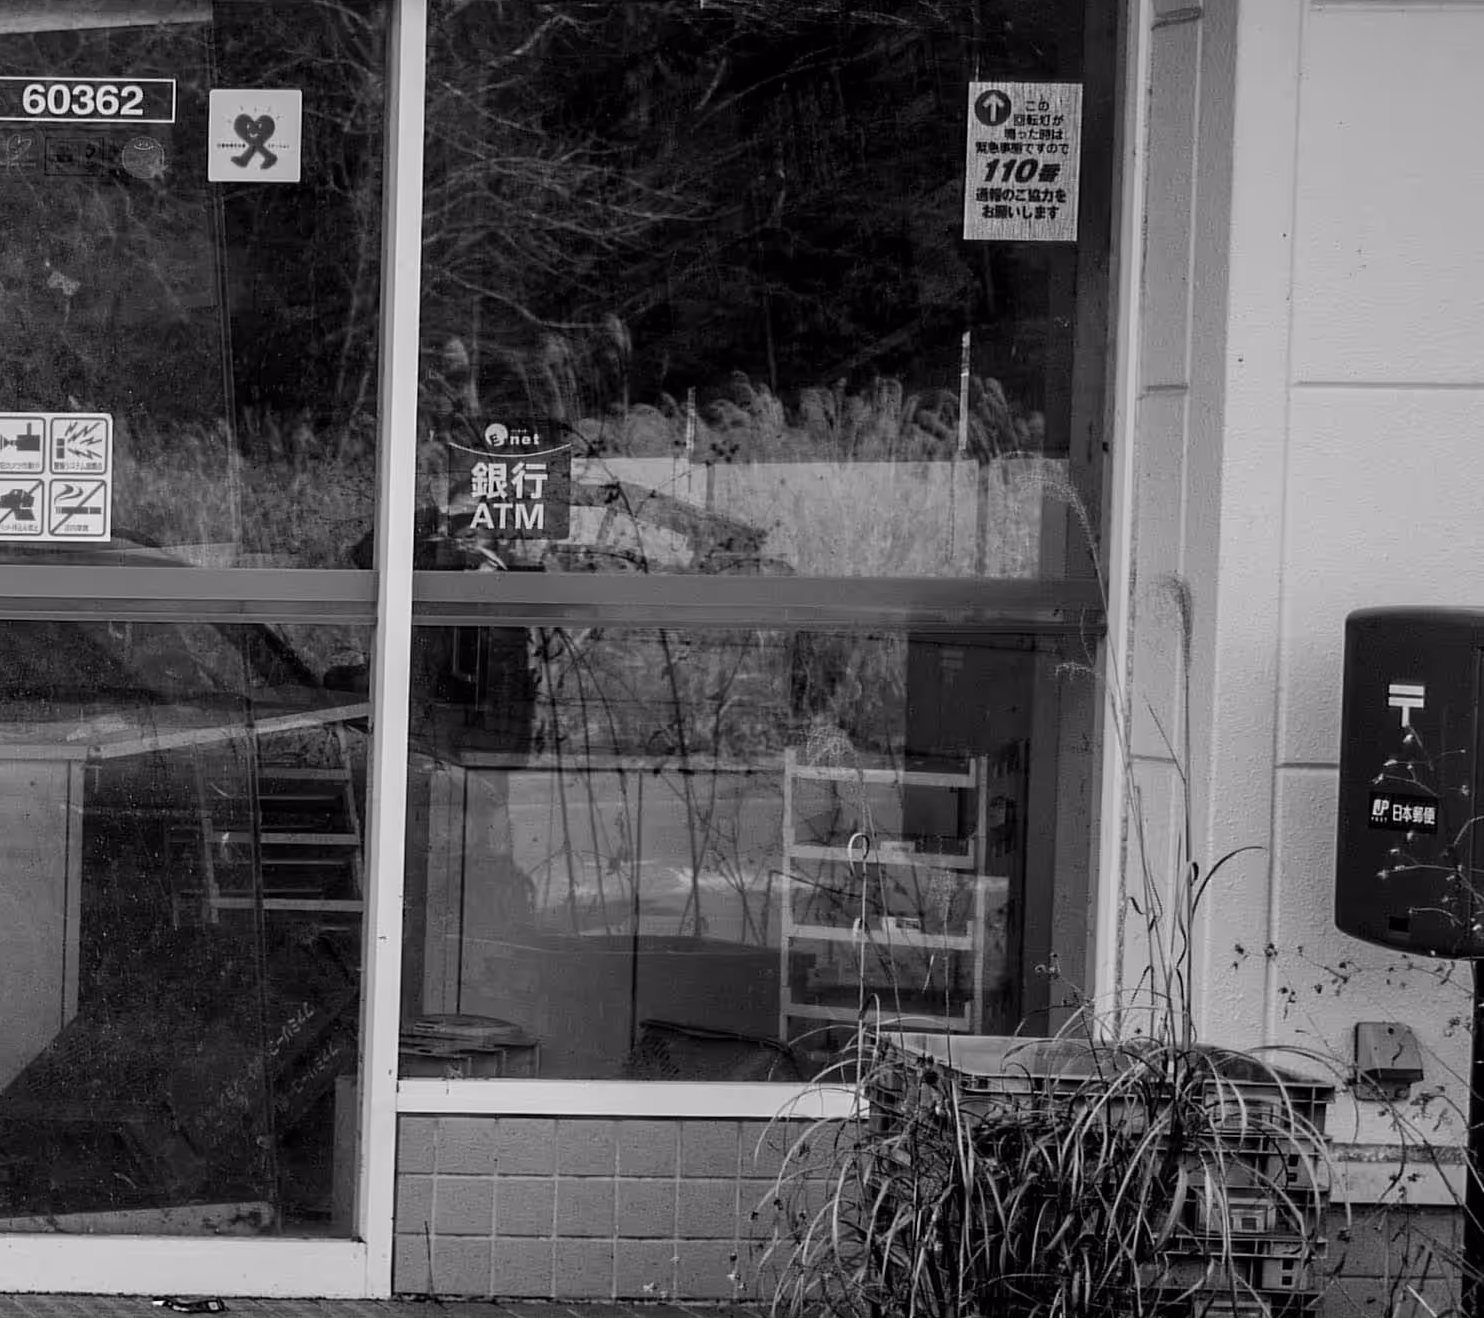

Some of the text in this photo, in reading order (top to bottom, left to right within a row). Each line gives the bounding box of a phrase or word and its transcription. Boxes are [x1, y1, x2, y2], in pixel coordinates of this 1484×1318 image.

[22, 84, 144, 116] 60362
[1026, 99, 1050, 112] この
[984, 158, 1061, 182] 110番
[975, 187, 1067, 203] 通報のご協力を
[471, 461, 549, 499] 銀行
[469, 502, 545, 530] ATM
[1392, 804, 1436, 824] 日本郵便
